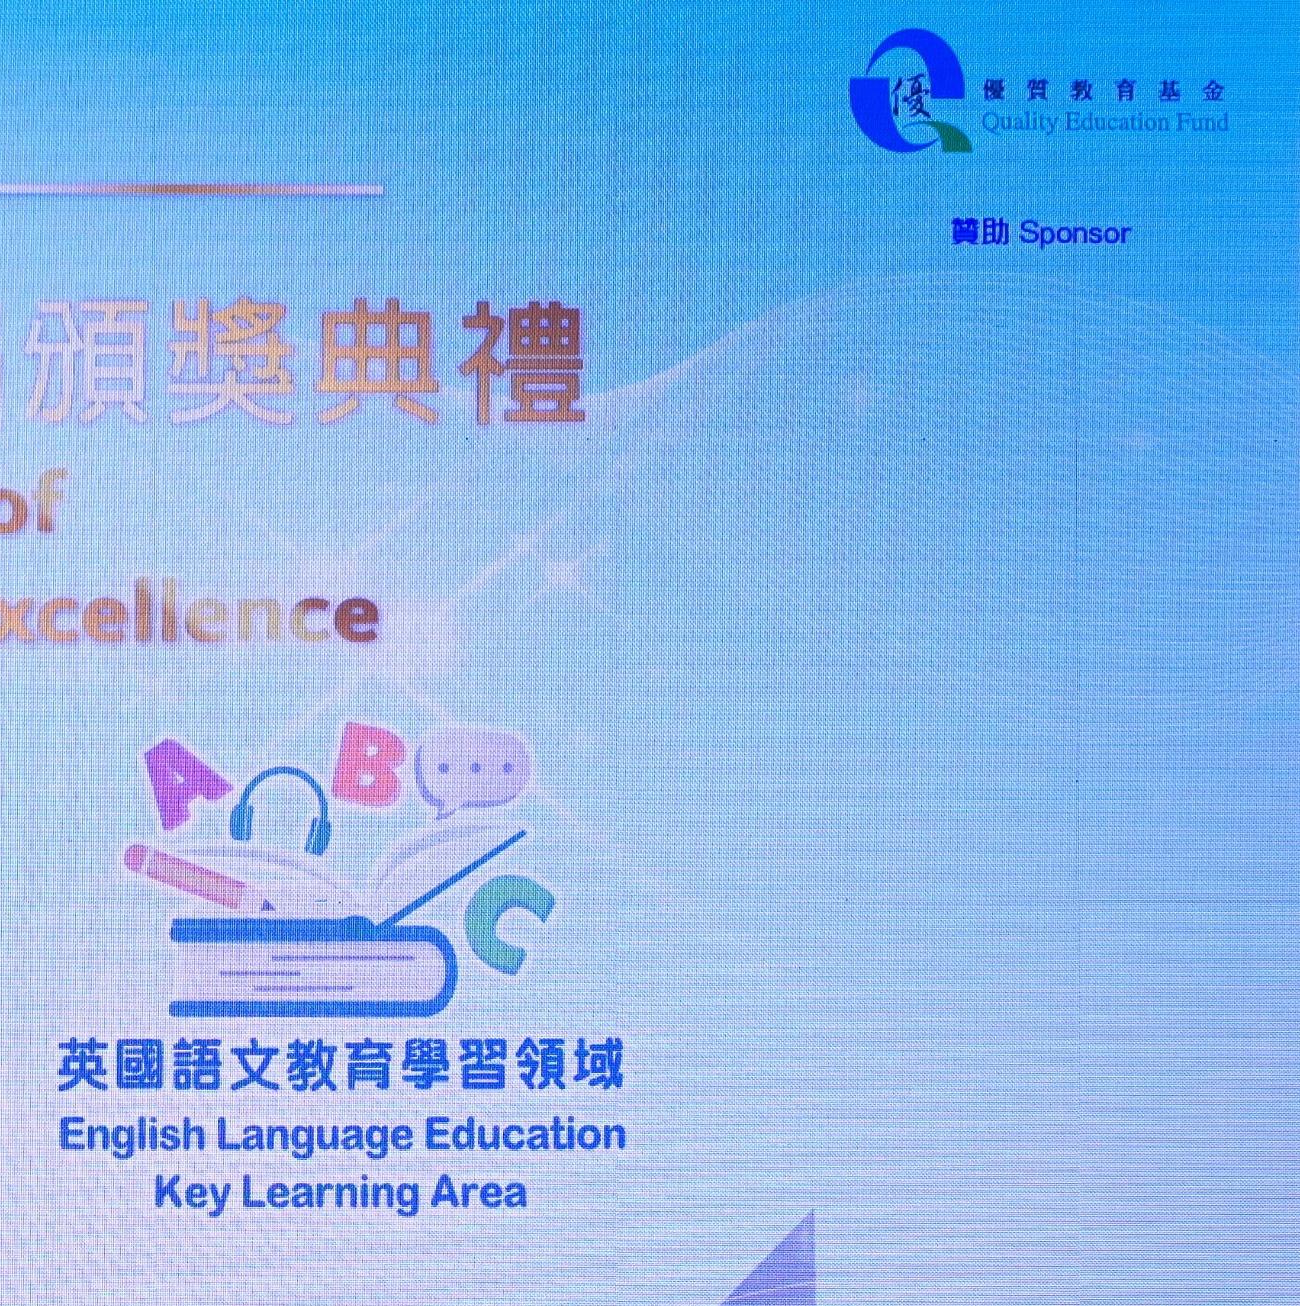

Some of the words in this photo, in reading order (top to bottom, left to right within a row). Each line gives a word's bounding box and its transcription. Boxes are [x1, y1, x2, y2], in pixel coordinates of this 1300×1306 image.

[983, 79, 1226, 102] 優質教育基金
[982, 111, 1058, 136] Quality
[1065, 111, 1169, 132] Education
[1177, 111, 1229, 132] Fund
[1019, 219, 1132, 250] Sponsor
[58, 1037, 624, 1091] 英國語文教育學習領域
[60, 1116, 206, 1159] English
[218, 1116, 413, 1160] Language
[425, 1115, 626, 1150] Education
[155, 1175, 230, 1217] Key
[242, 1174, 419, 1217] Learning
[431, 1174, 528, 1208] Area
